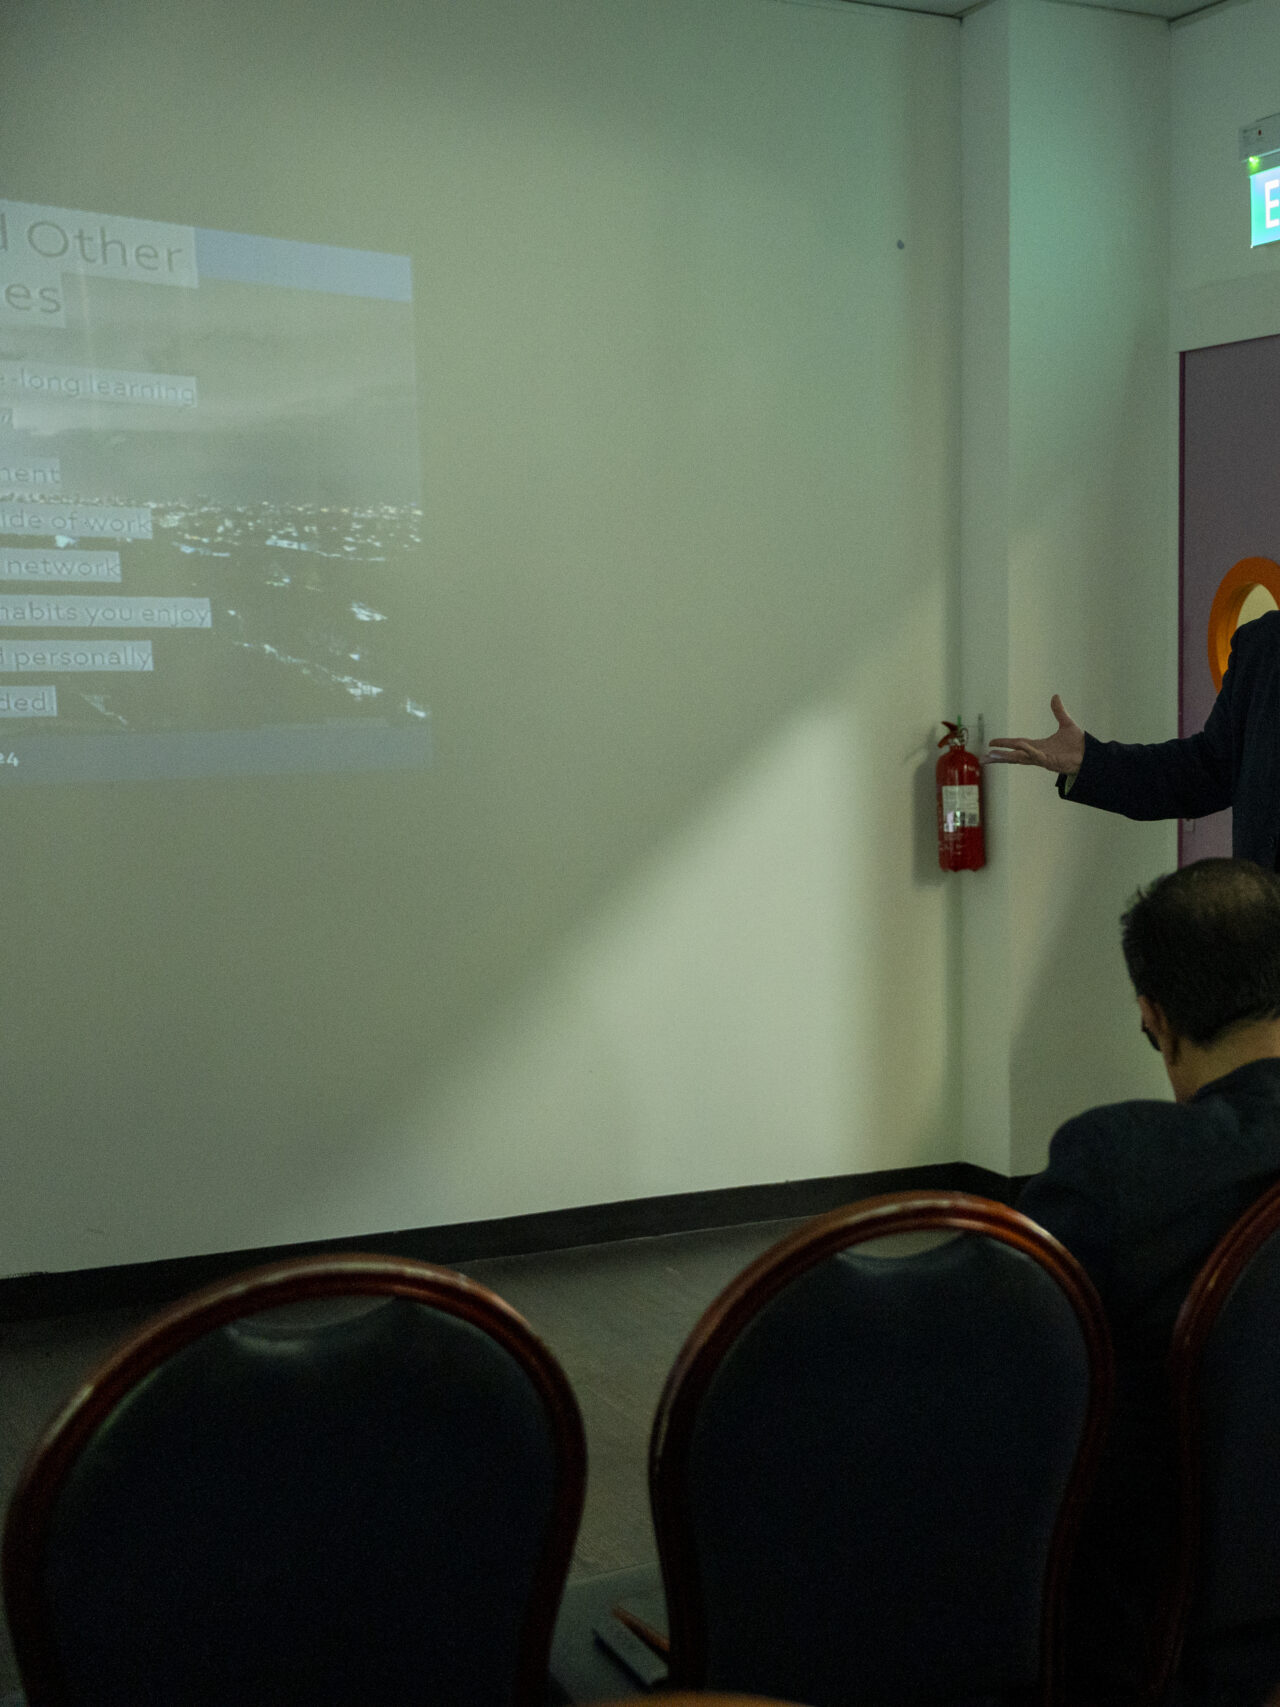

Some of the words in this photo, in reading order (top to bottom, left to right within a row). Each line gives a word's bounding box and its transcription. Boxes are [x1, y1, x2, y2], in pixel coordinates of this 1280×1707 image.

[27, 219, 183, 272] Other
[90, 373, 197, 407] learning
[51, 510, 78, 530] of
[84, 515, 152, 533] work
[7, 557, 121, 577] network
[84, 607, 133, 627] you
[142, 604, 212, 628] enjoy
[15, 645, 152, 672] personally
